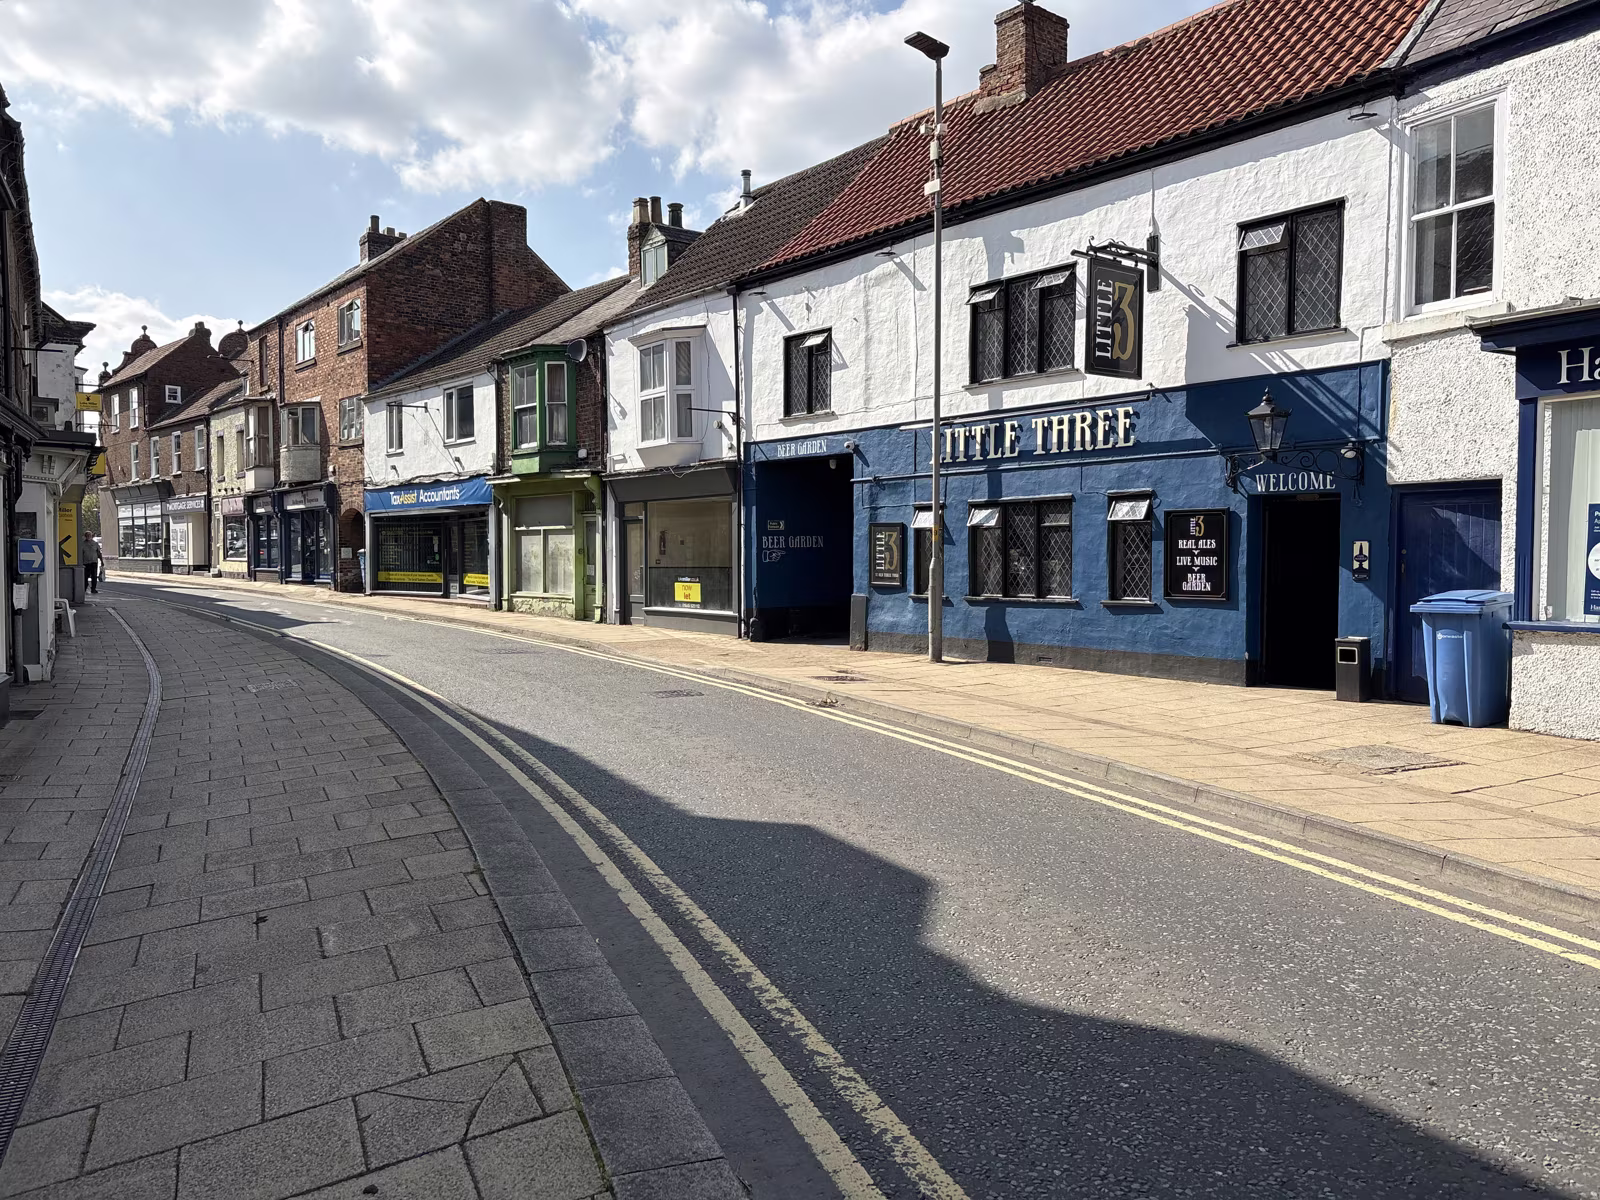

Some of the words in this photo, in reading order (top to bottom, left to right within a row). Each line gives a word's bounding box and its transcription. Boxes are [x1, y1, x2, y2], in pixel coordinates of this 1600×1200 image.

[1096, 279, 1113, 360] LITTLE
[1113, 281, 1135, 361] 3
[1031, 406, 1135, 455] THREE
[777, 443, 796, 457] BEER
[797, 439, 827, 455] GARDEN
[1255, 471, 1336, 492] WELCOME
[389, 490, 417, 505] TaxAssist
[419, 486, 460, 503] Accountants
[1195, 515, 1205, 537] 3
[762, 535, 786, 549] BEER
[788, 535, 824, 549] GARDEN
[1178, 539, 1196, 549] REAL
[1198, 539, 1216, 549] ALES
[876, 531, 885, 570] LITTLE
[884, 531, 898, 570] 3
[1176, 556, 1192, 566] LIVE
[1194, 556, 1218, 566] MUSIC
[1187, 573, 1206, 582] BEER
[681, 584, 693, 592] now
[1182, 581, 1211, 591] GARDEN
[683, 592, 692, 600] let
